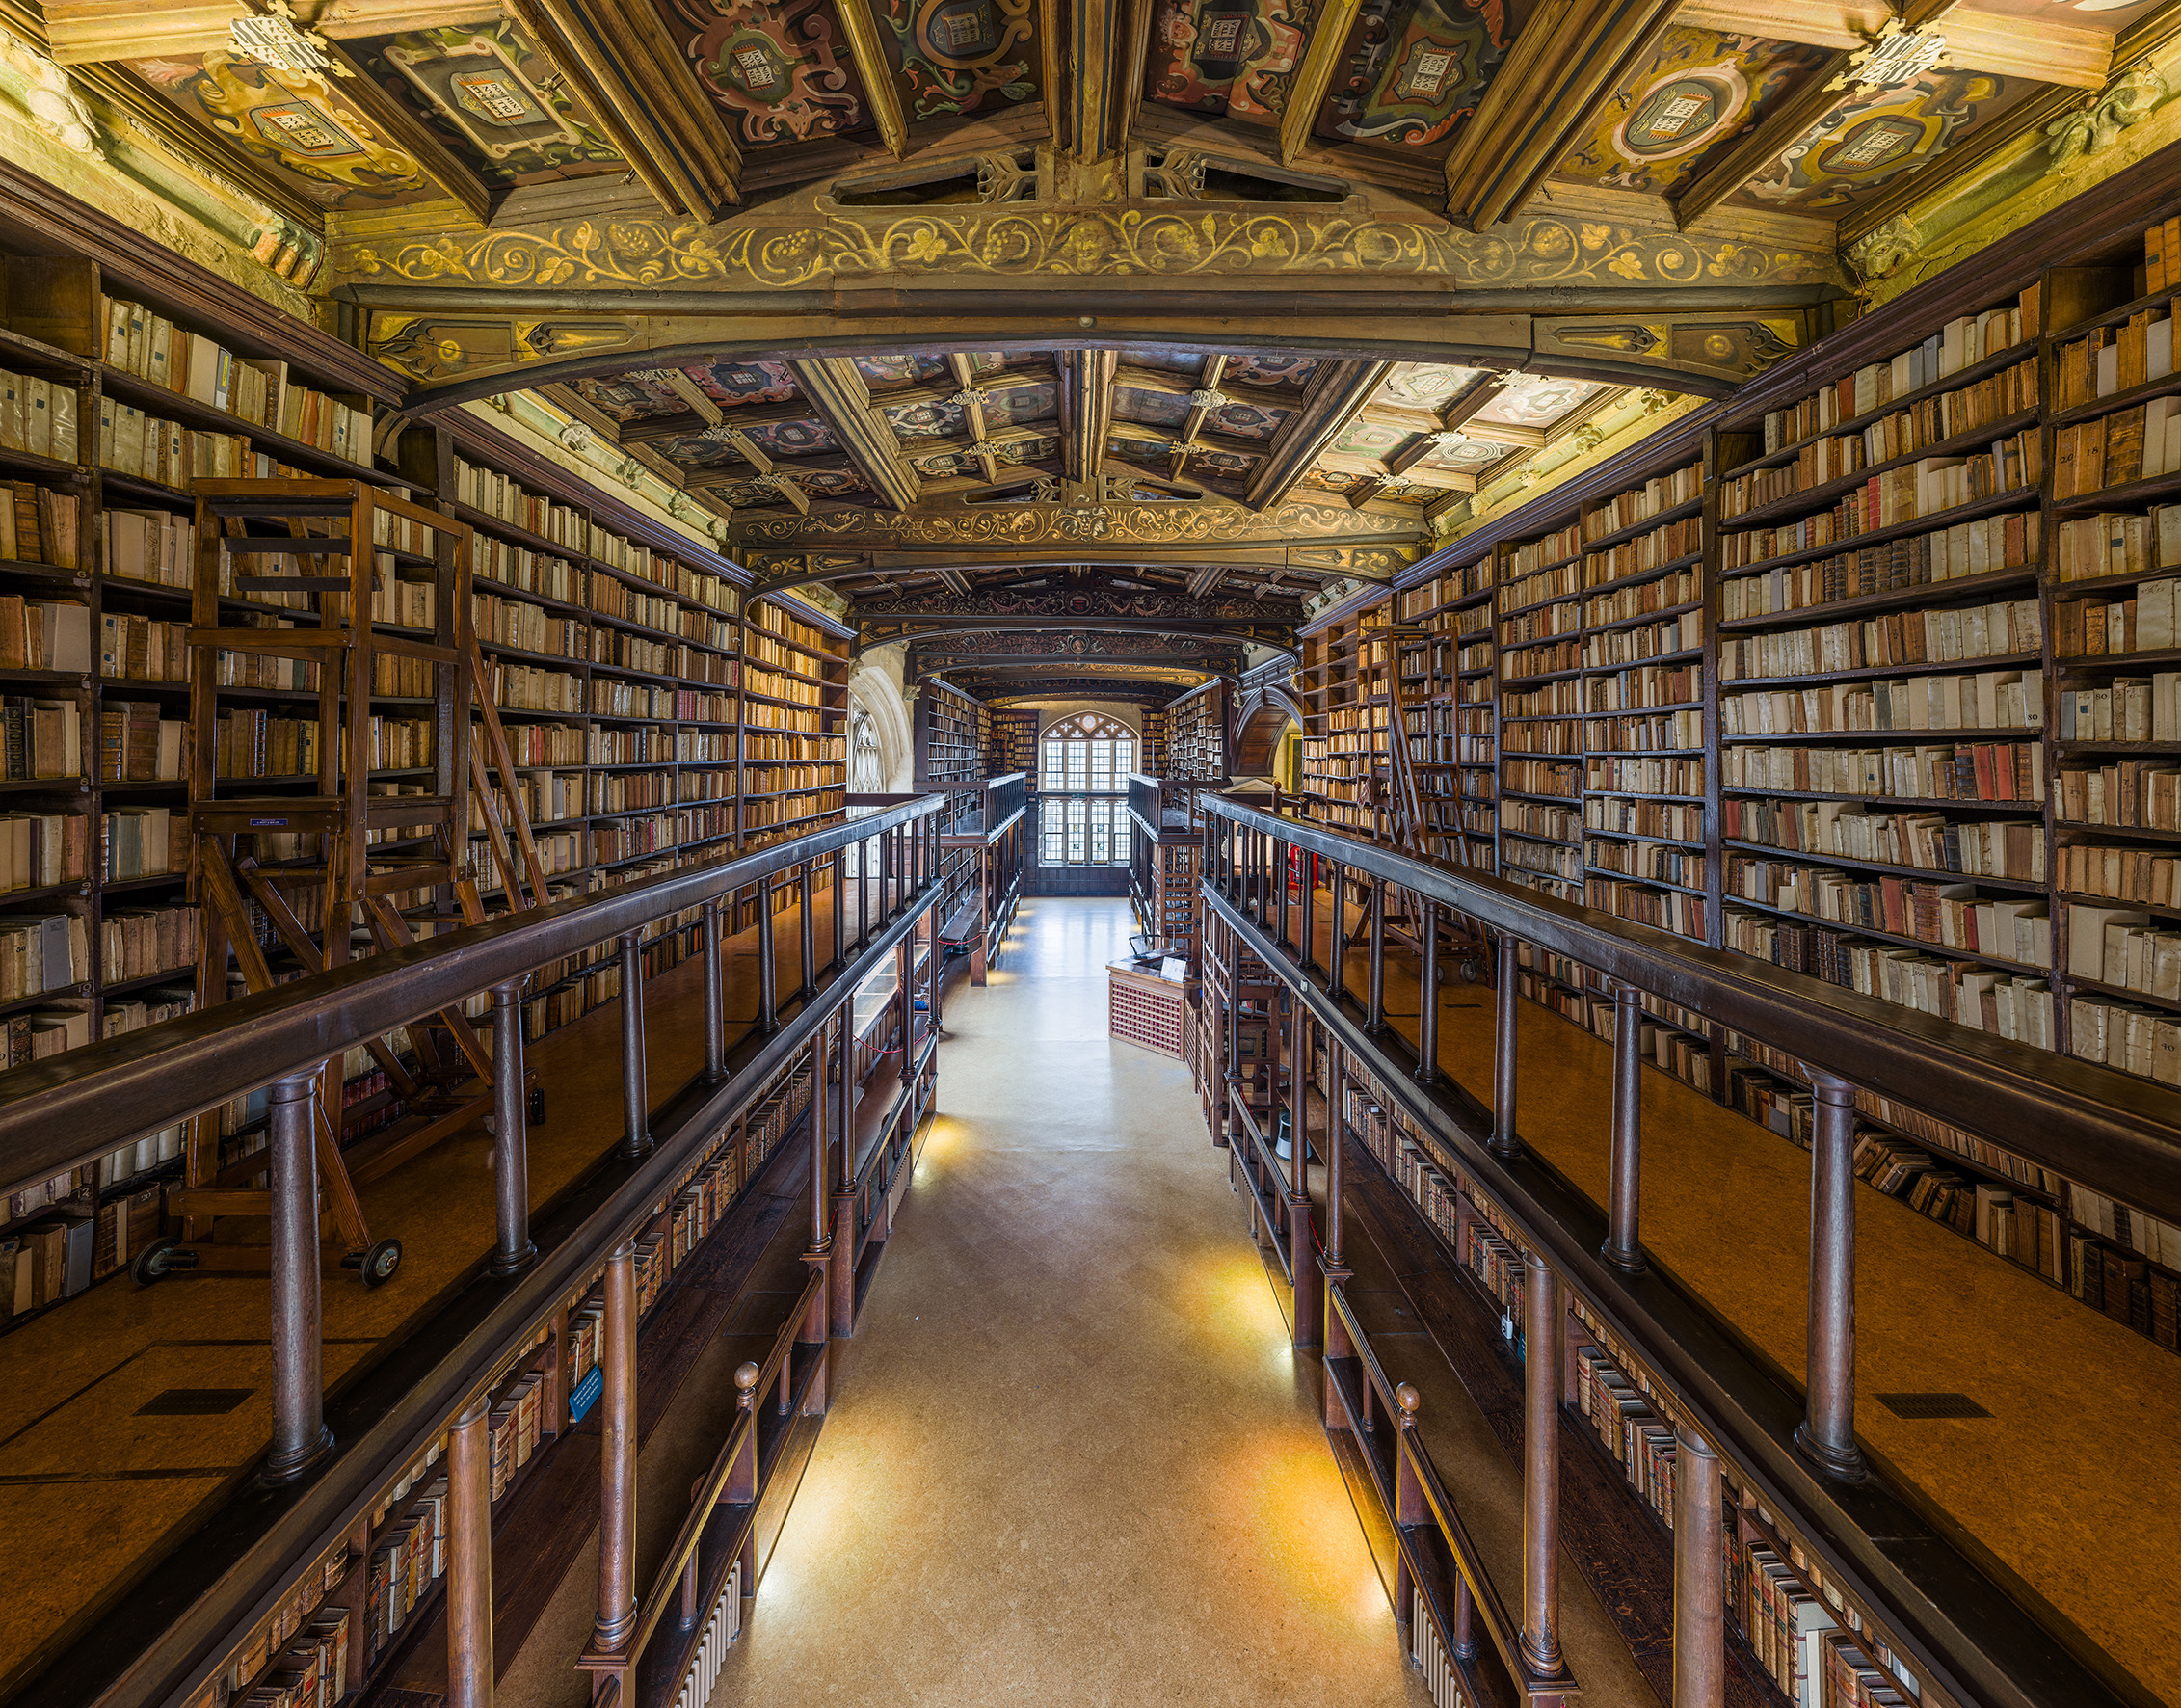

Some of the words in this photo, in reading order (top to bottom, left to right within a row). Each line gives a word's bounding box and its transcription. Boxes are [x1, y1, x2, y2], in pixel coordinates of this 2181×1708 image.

[2086, 446, 2099, 457] 18
[2059, 453, 2074, 464] 20
[76, 465, 87, 474] 5
[76, 571, 87, 579] 6
[78, 983, 92, 993] 10
[2160, 1042, 2175, 1053] 40
